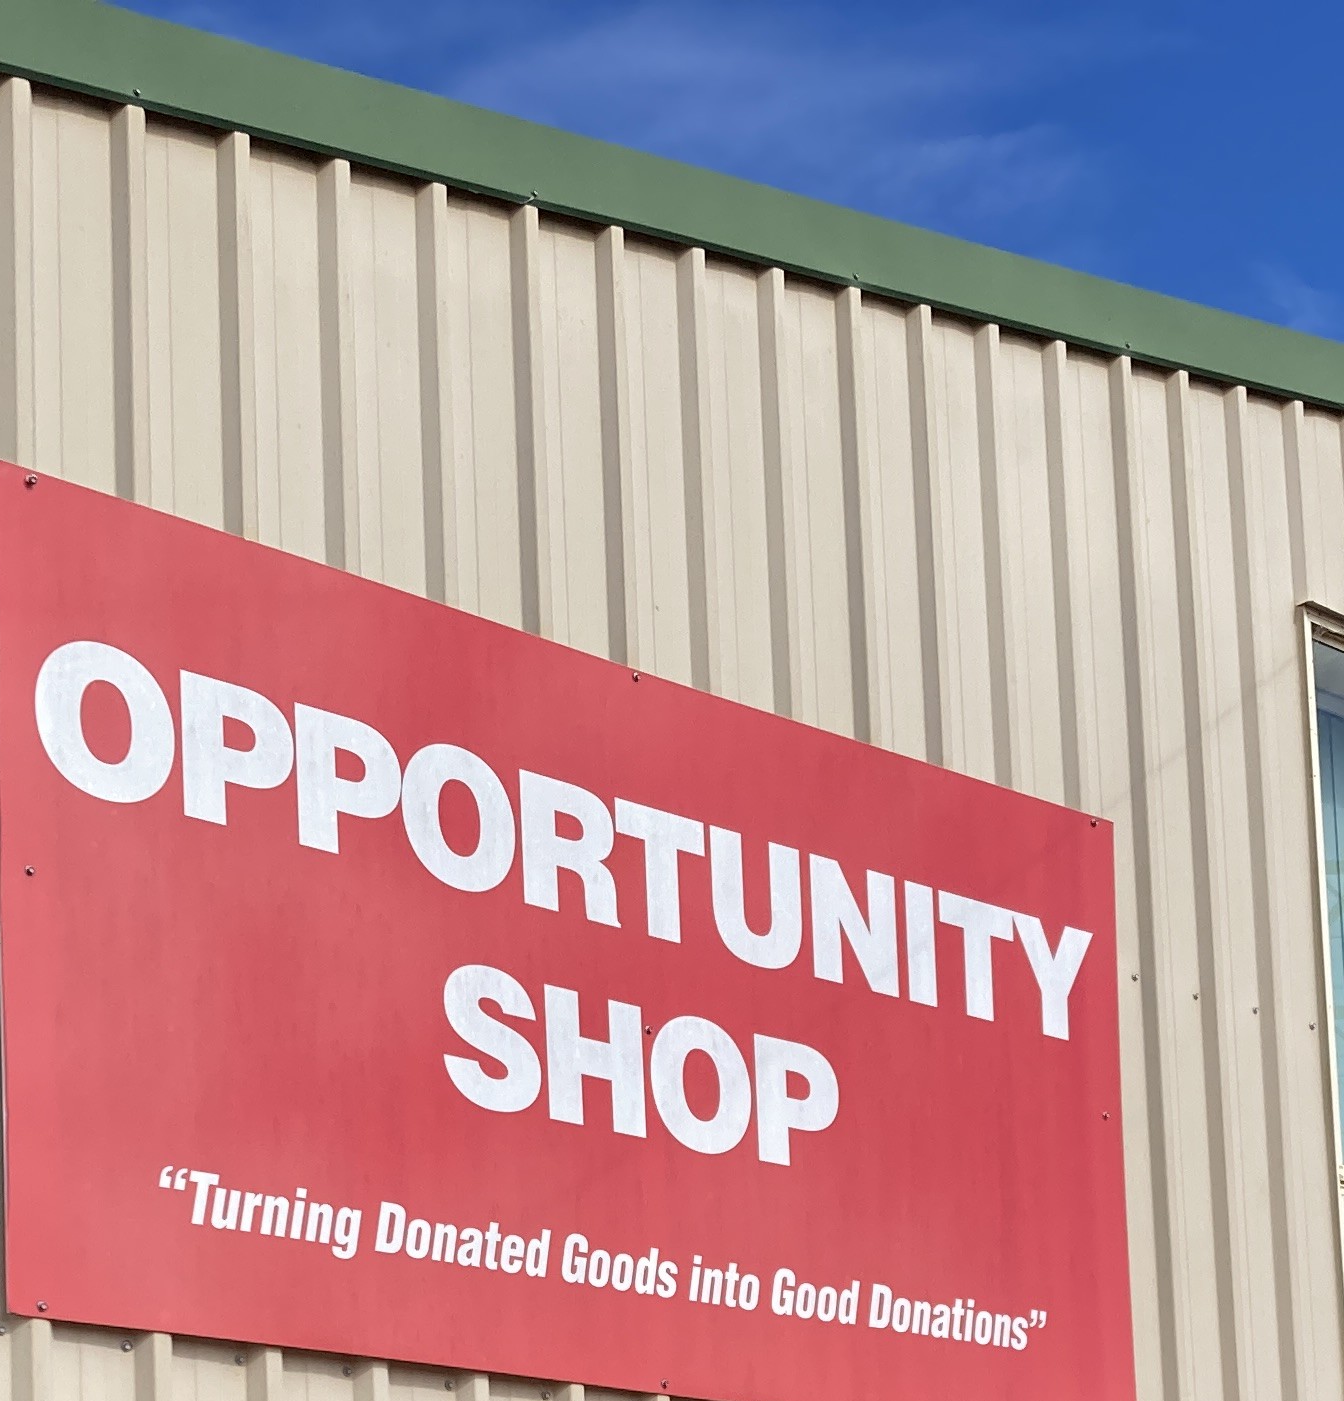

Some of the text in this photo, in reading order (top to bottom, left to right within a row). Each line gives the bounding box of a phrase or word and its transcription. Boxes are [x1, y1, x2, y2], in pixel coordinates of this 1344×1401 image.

[35, 640, 1092, 1041] OPPORTUNITY
[442, 964, 839, 1166] SHOP
[158, 1164, 1049, 1351] “Turning Donated Goods into Good Donations”
